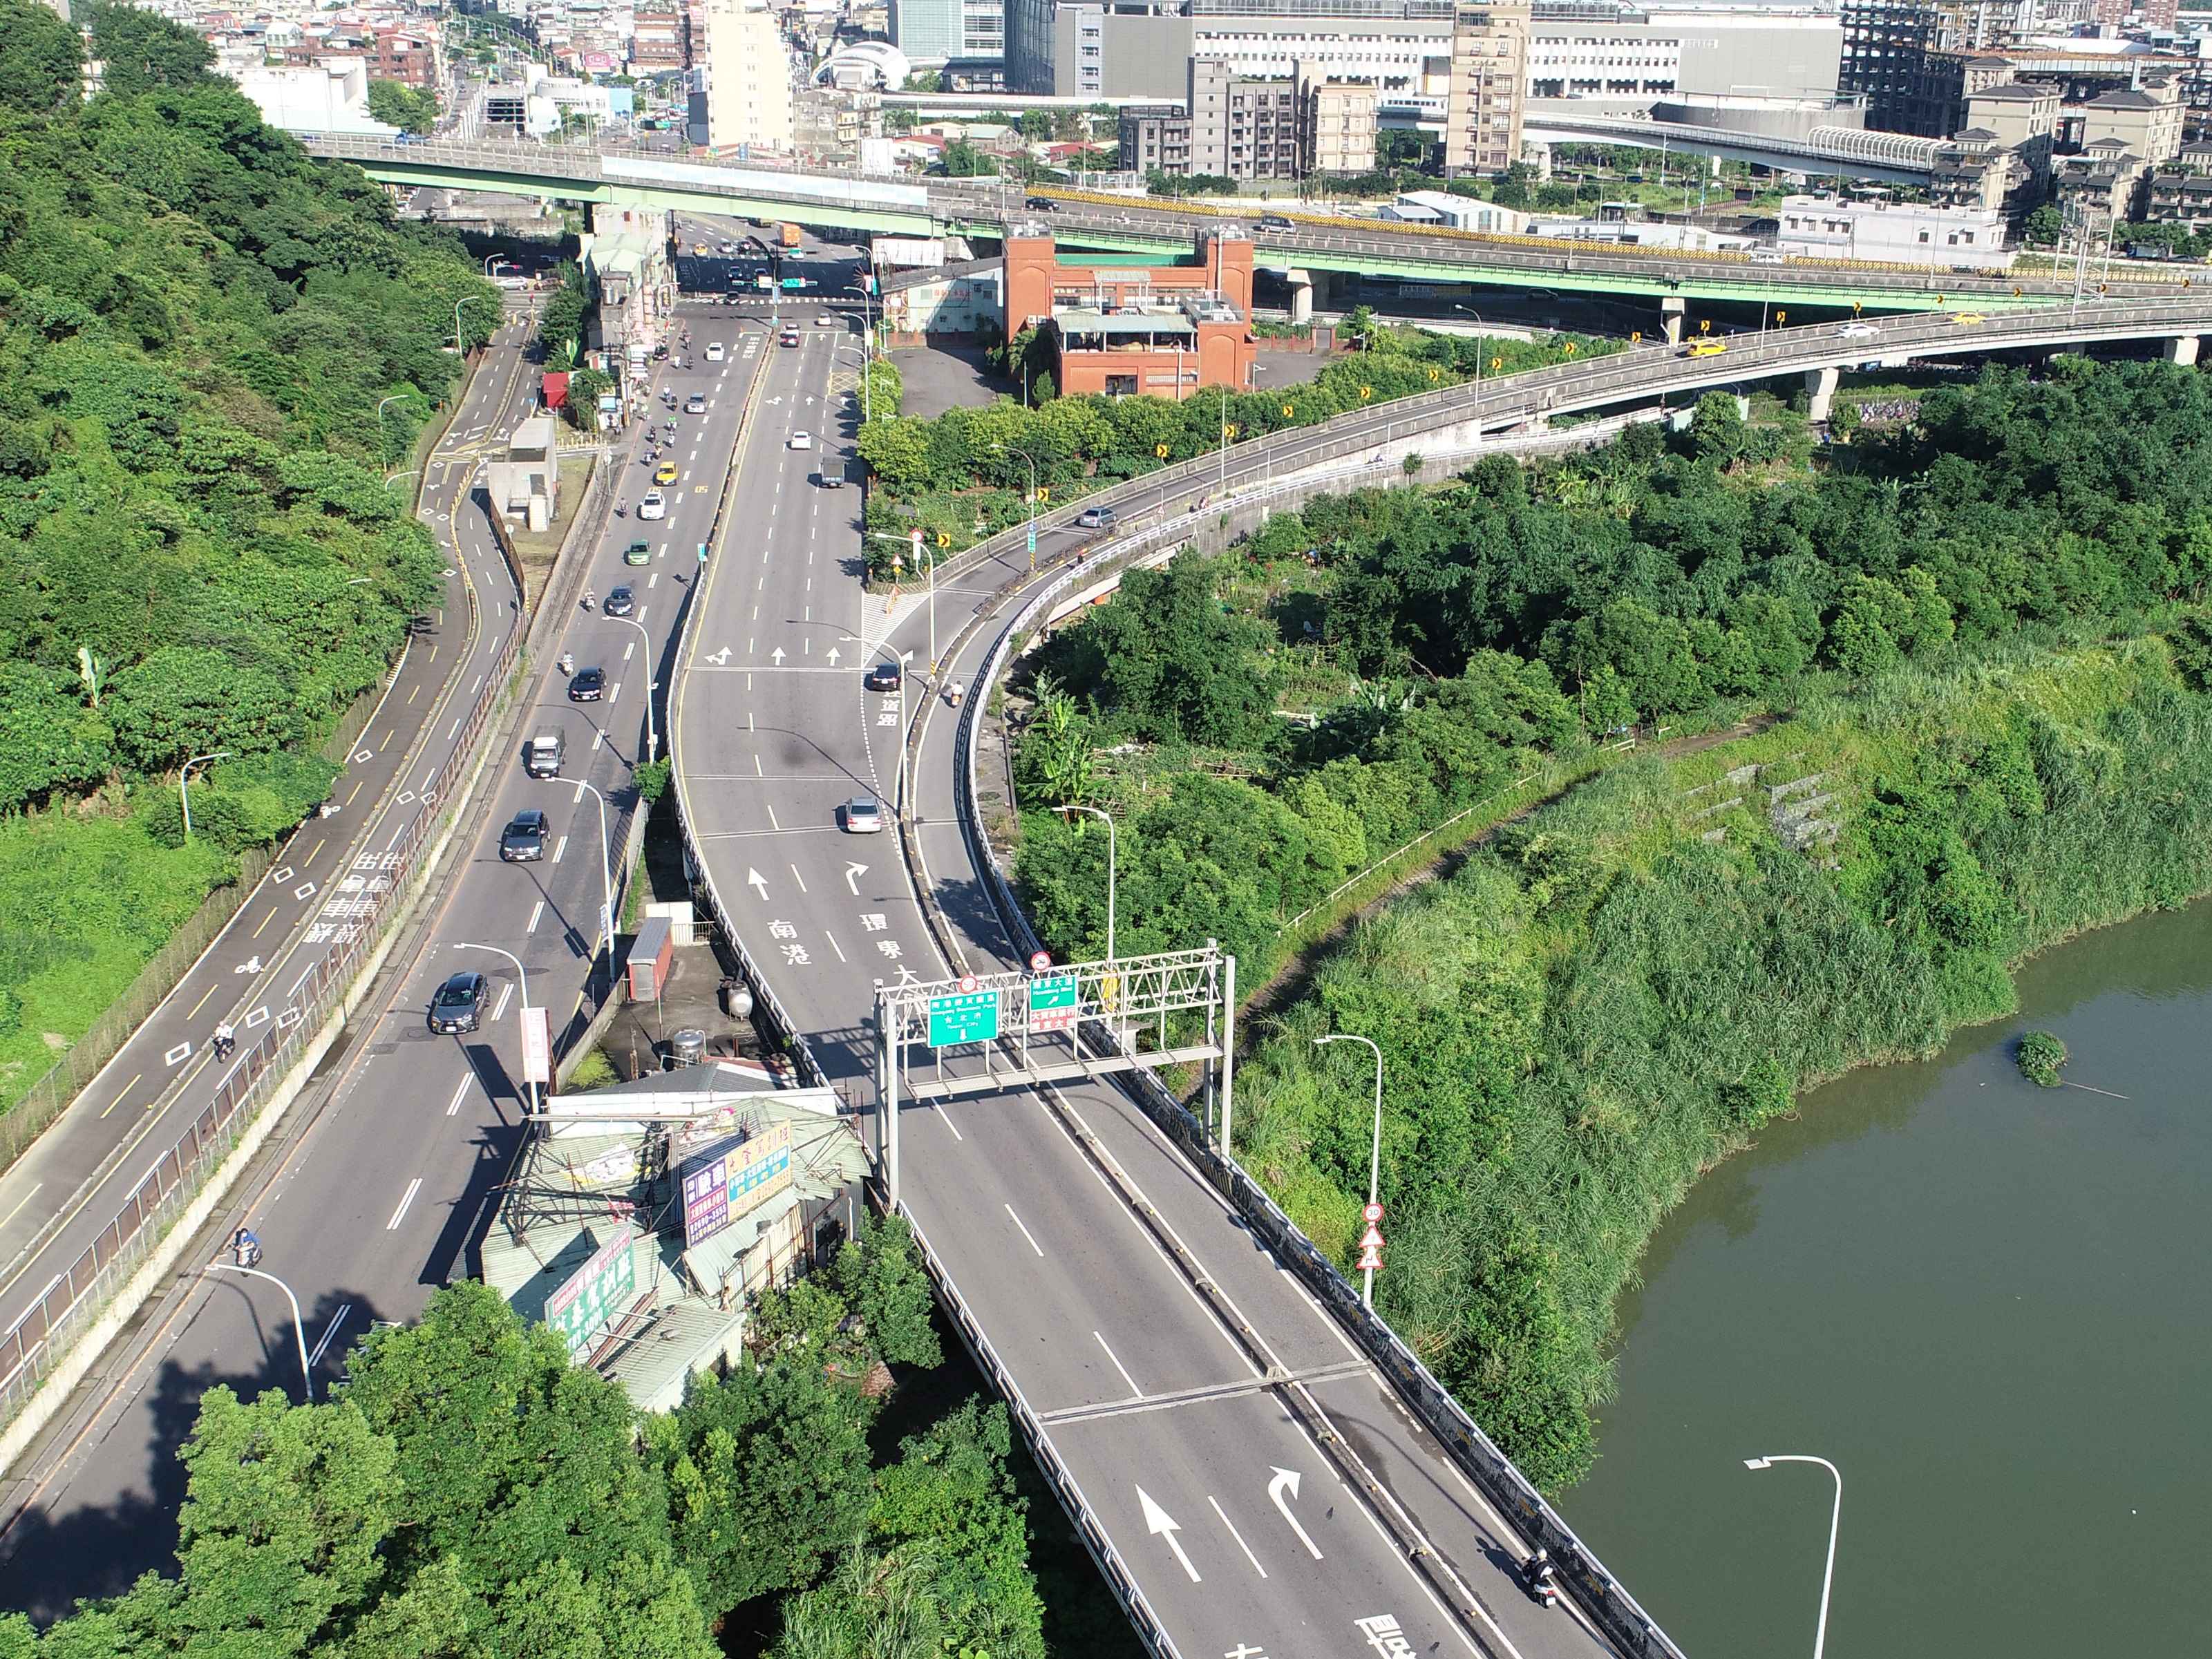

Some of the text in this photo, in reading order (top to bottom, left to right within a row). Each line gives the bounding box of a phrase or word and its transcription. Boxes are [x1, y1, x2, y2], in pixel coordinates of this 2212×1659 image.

[767, 919, 812, 965] 南港
[944, 1012, 982, 1024] 台北市
[698, 1163, 726, 1197] 驗車
